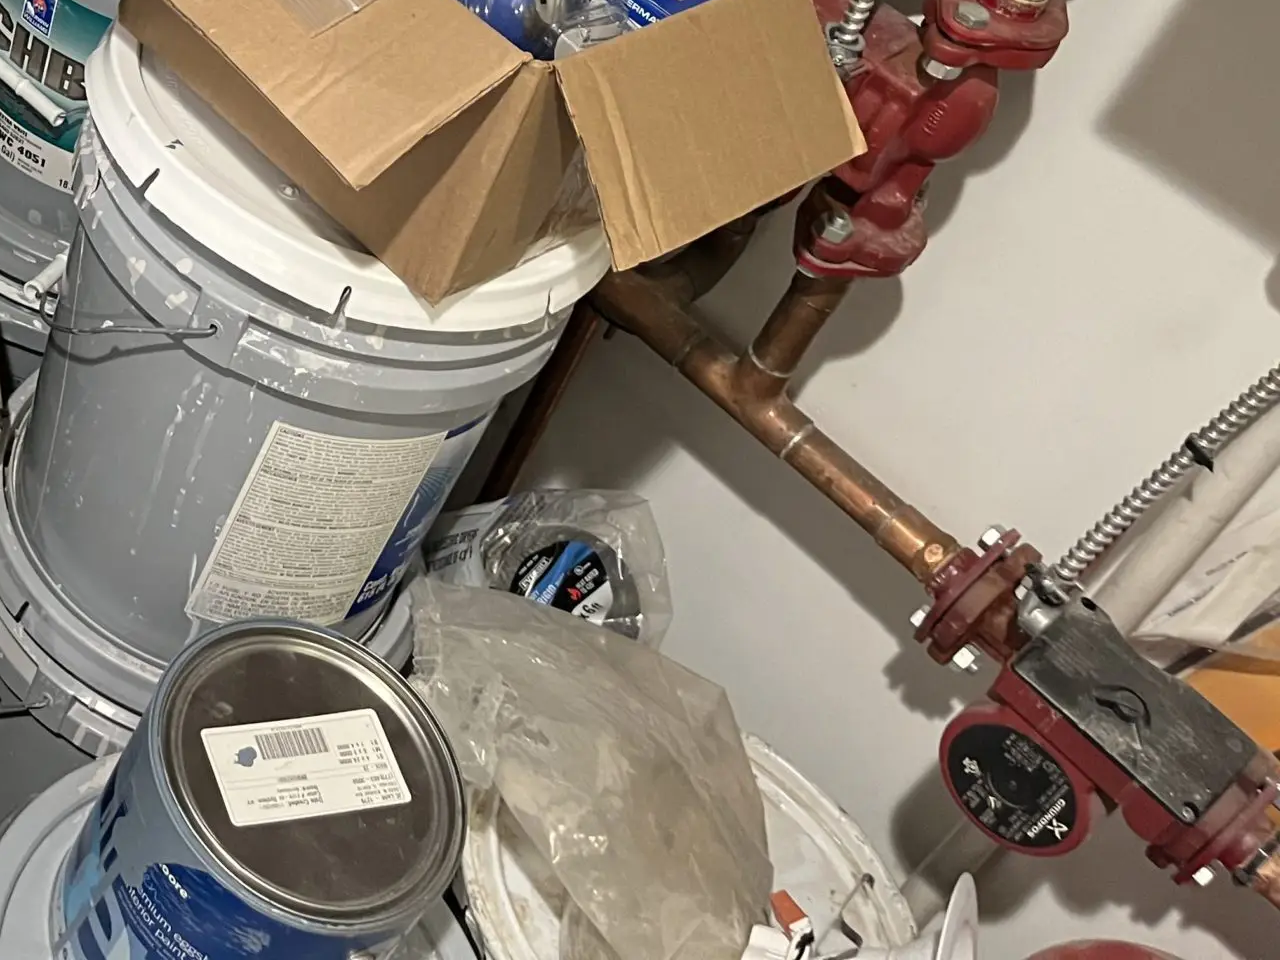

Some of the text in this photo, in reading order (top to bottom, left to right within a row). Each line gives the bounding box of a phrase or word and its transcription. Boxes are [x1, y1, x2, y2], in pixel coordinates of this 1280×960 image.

[0, 129, 14, 148] WC
[17, 144, 46, 168] 4051
[160, 863, 188, 900] oore
[127, 883, 156, 927] nterior
[154, 928, 187, 960] paint
